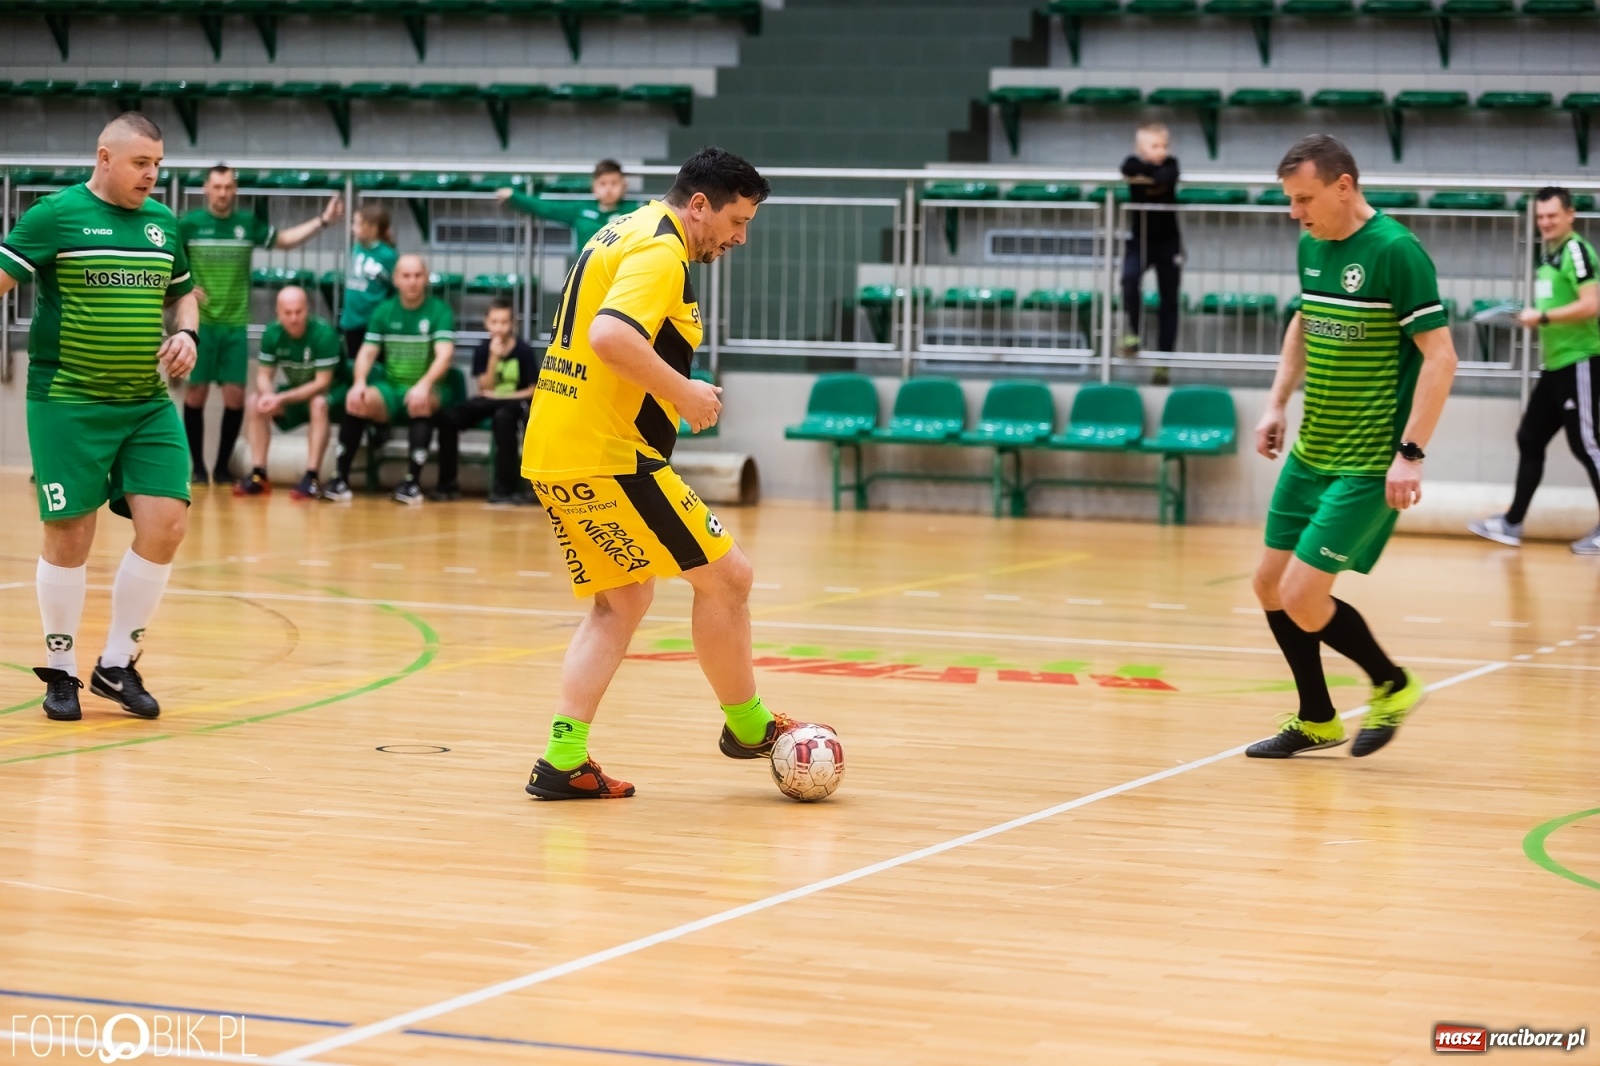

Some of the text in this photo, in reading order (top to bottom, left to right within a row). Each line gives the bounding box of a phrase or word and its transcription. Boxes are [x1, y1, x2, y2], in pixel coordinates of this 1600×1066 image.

[43, 482, 66, 511] 13
[588, 500, 618, 513] Pracy
[600, 522, 650, 567] PRACA
